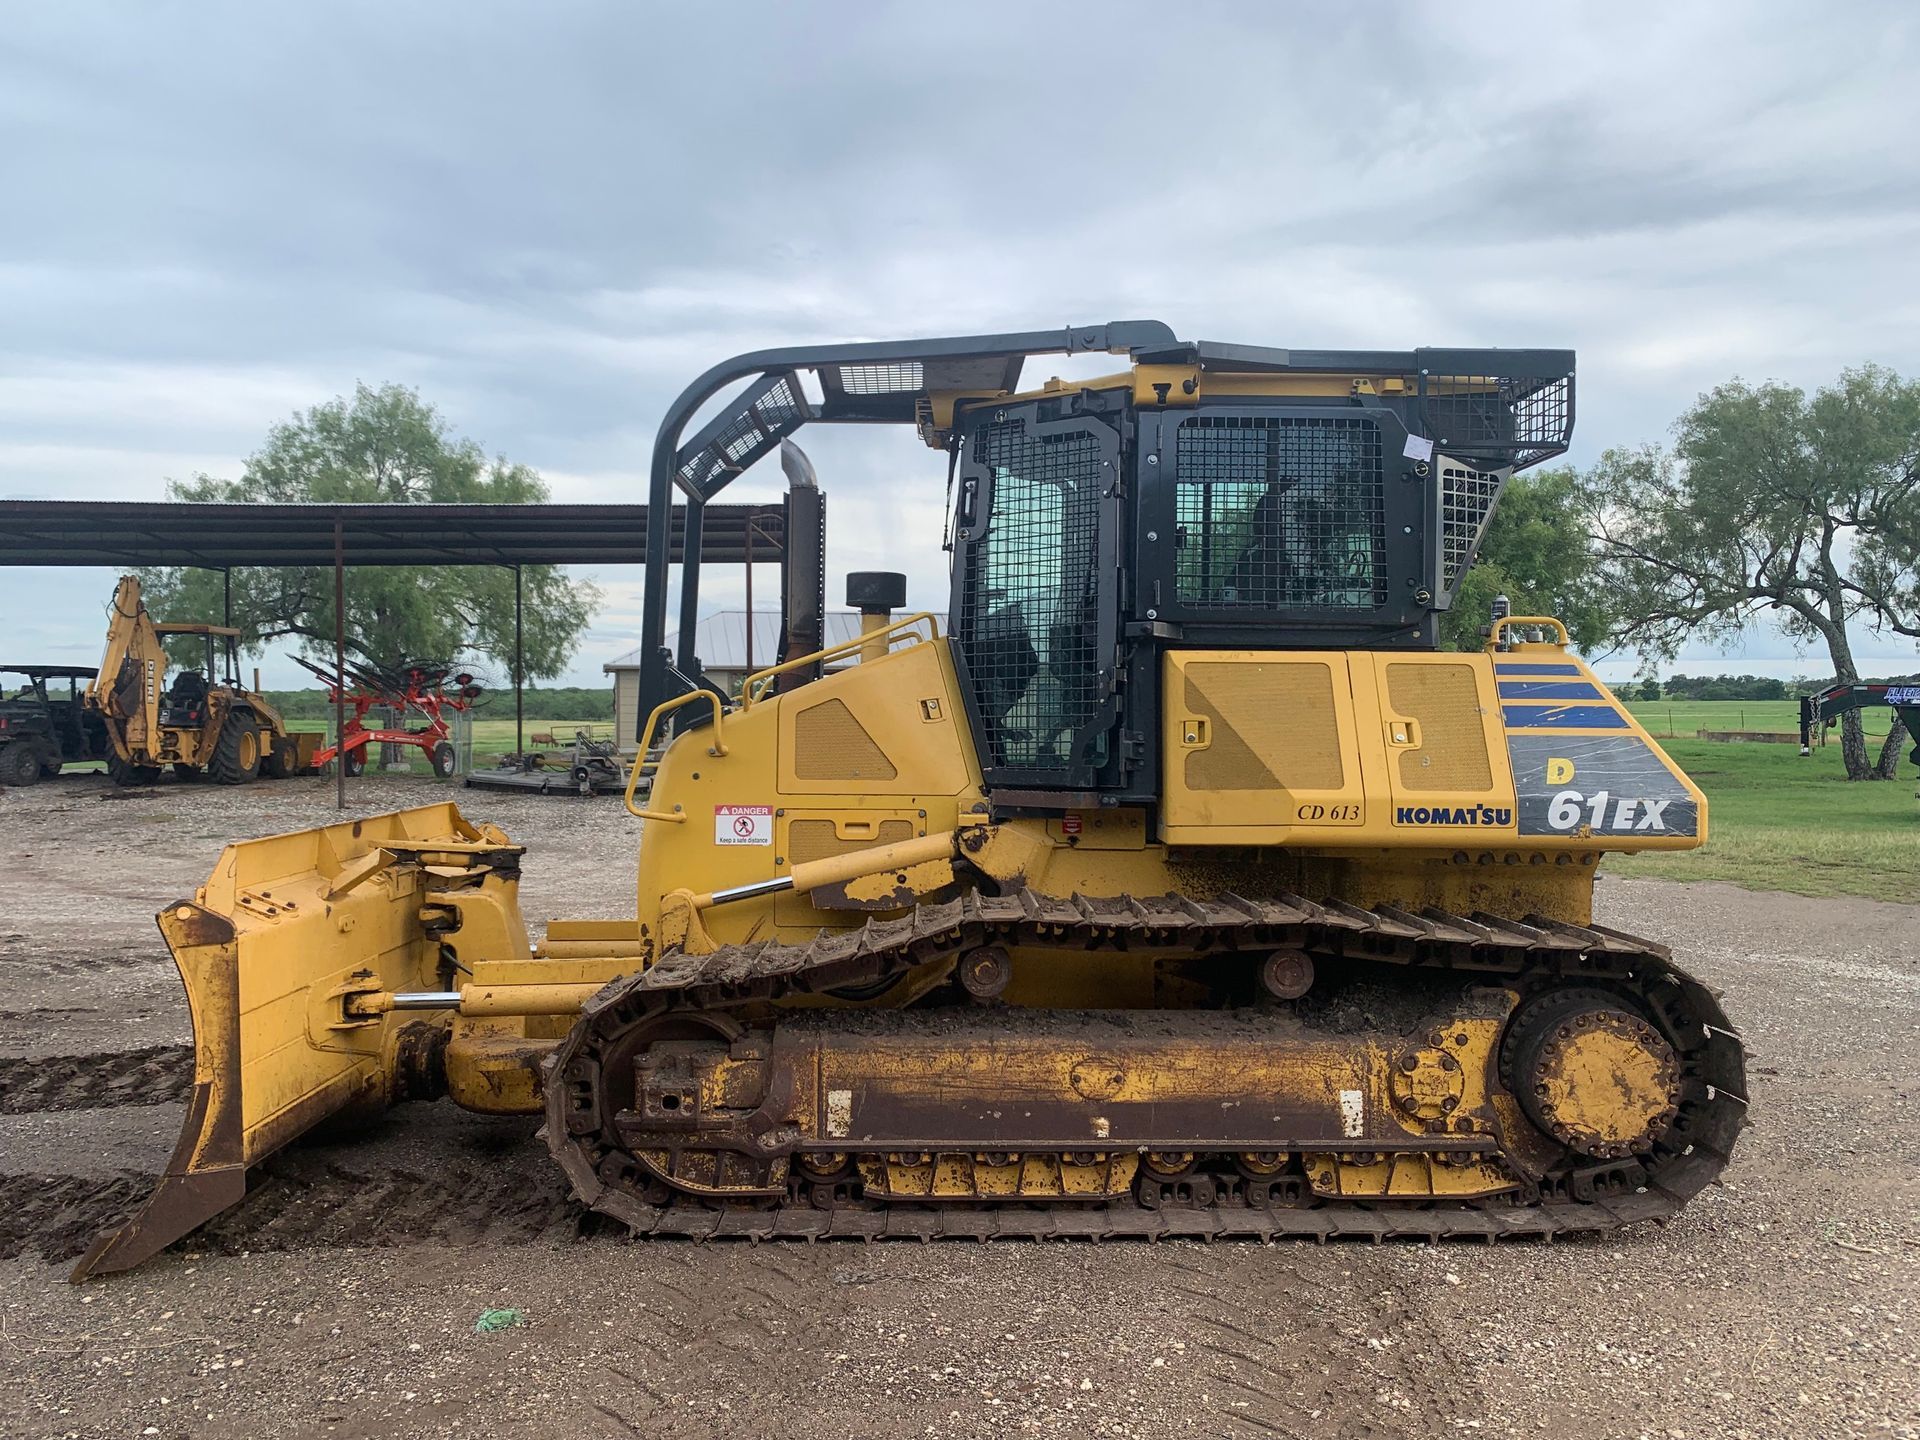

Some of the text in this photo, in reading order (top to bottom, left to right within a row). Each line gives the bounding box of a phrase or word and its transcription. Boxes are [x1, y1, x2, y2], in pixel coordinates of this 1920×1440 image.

[1546, 757, 1576, 785] D
[1297, 804, 1361, 821] CD 613
[1396, 803, 1512, 826] KOMATSU
[1546, 790, 1673, 831] 61EX
